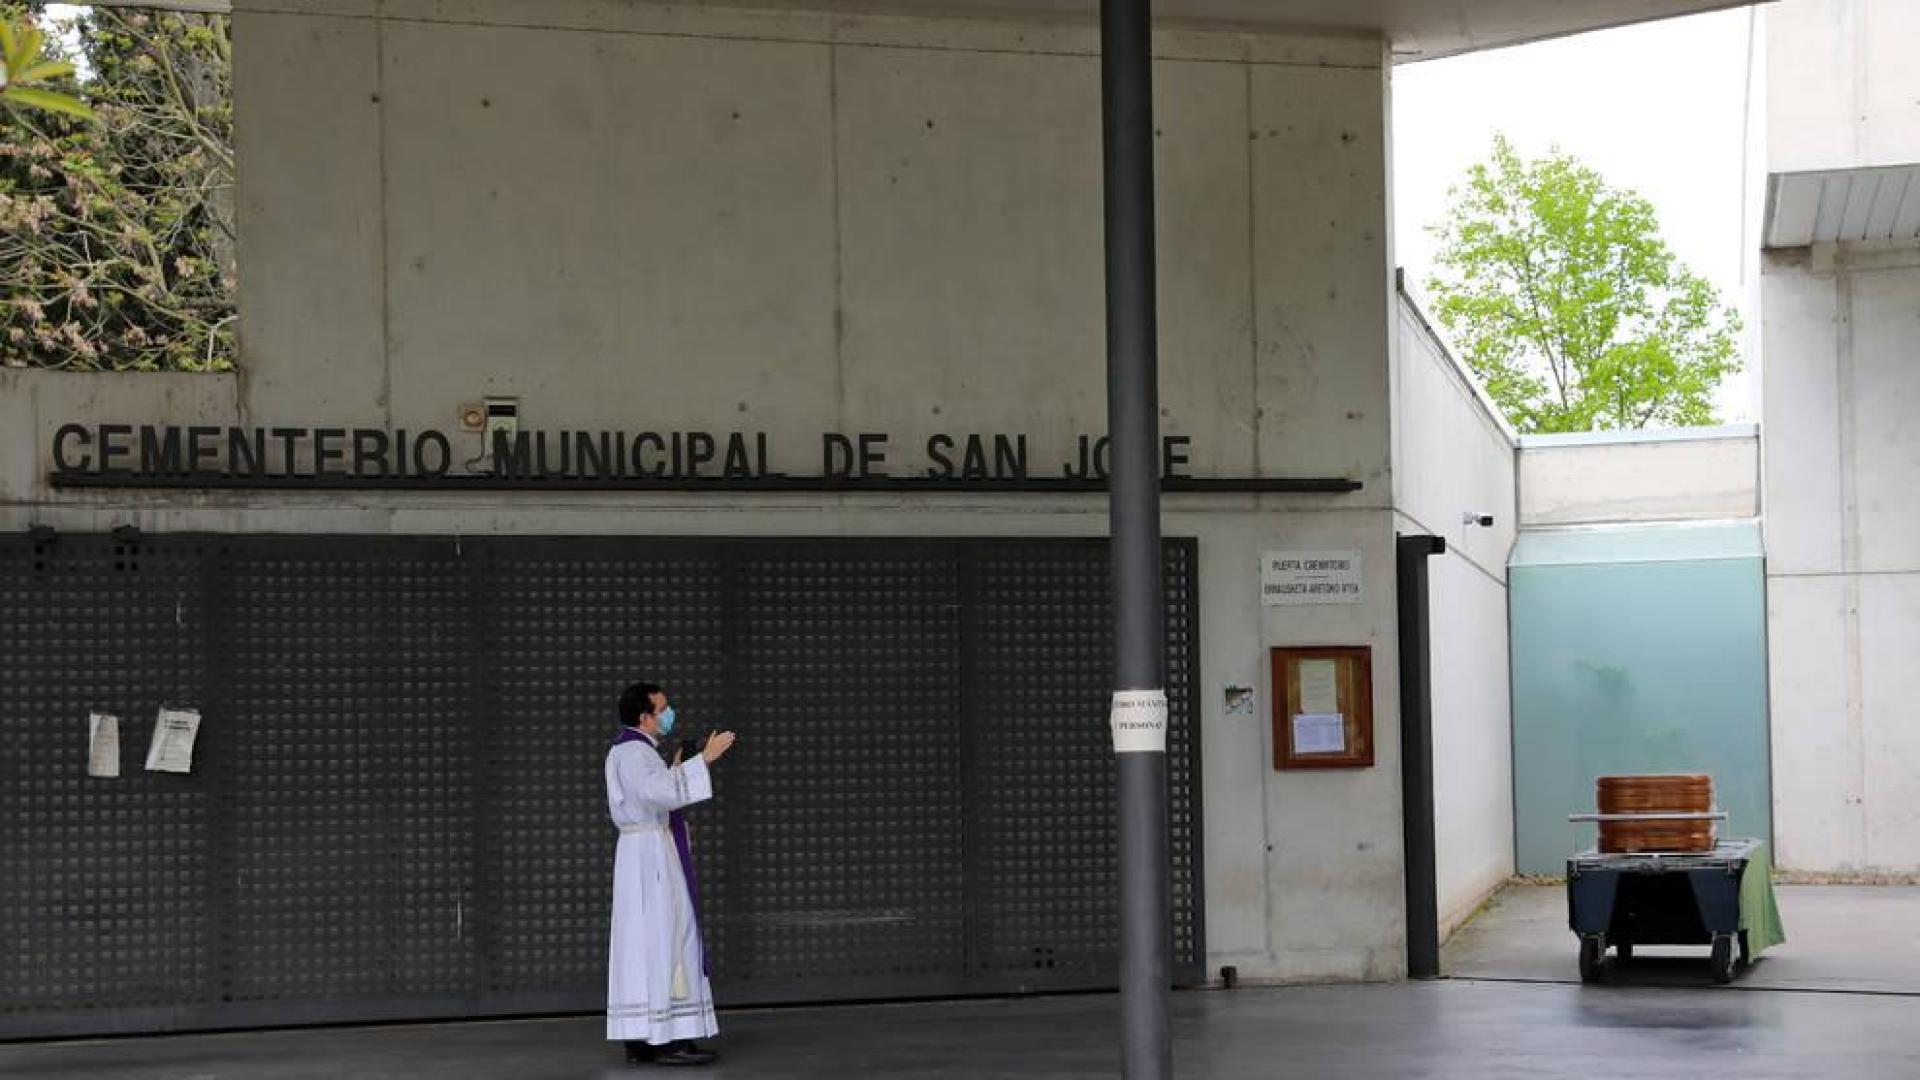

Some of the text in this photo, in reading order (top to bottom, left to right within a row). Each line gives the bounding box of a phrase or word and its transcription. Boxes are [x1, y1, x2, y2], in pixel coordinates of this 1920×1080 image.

[53, 424, 1192, 479] CEMENTERIO MUNICIPAL DE SAN JOE
